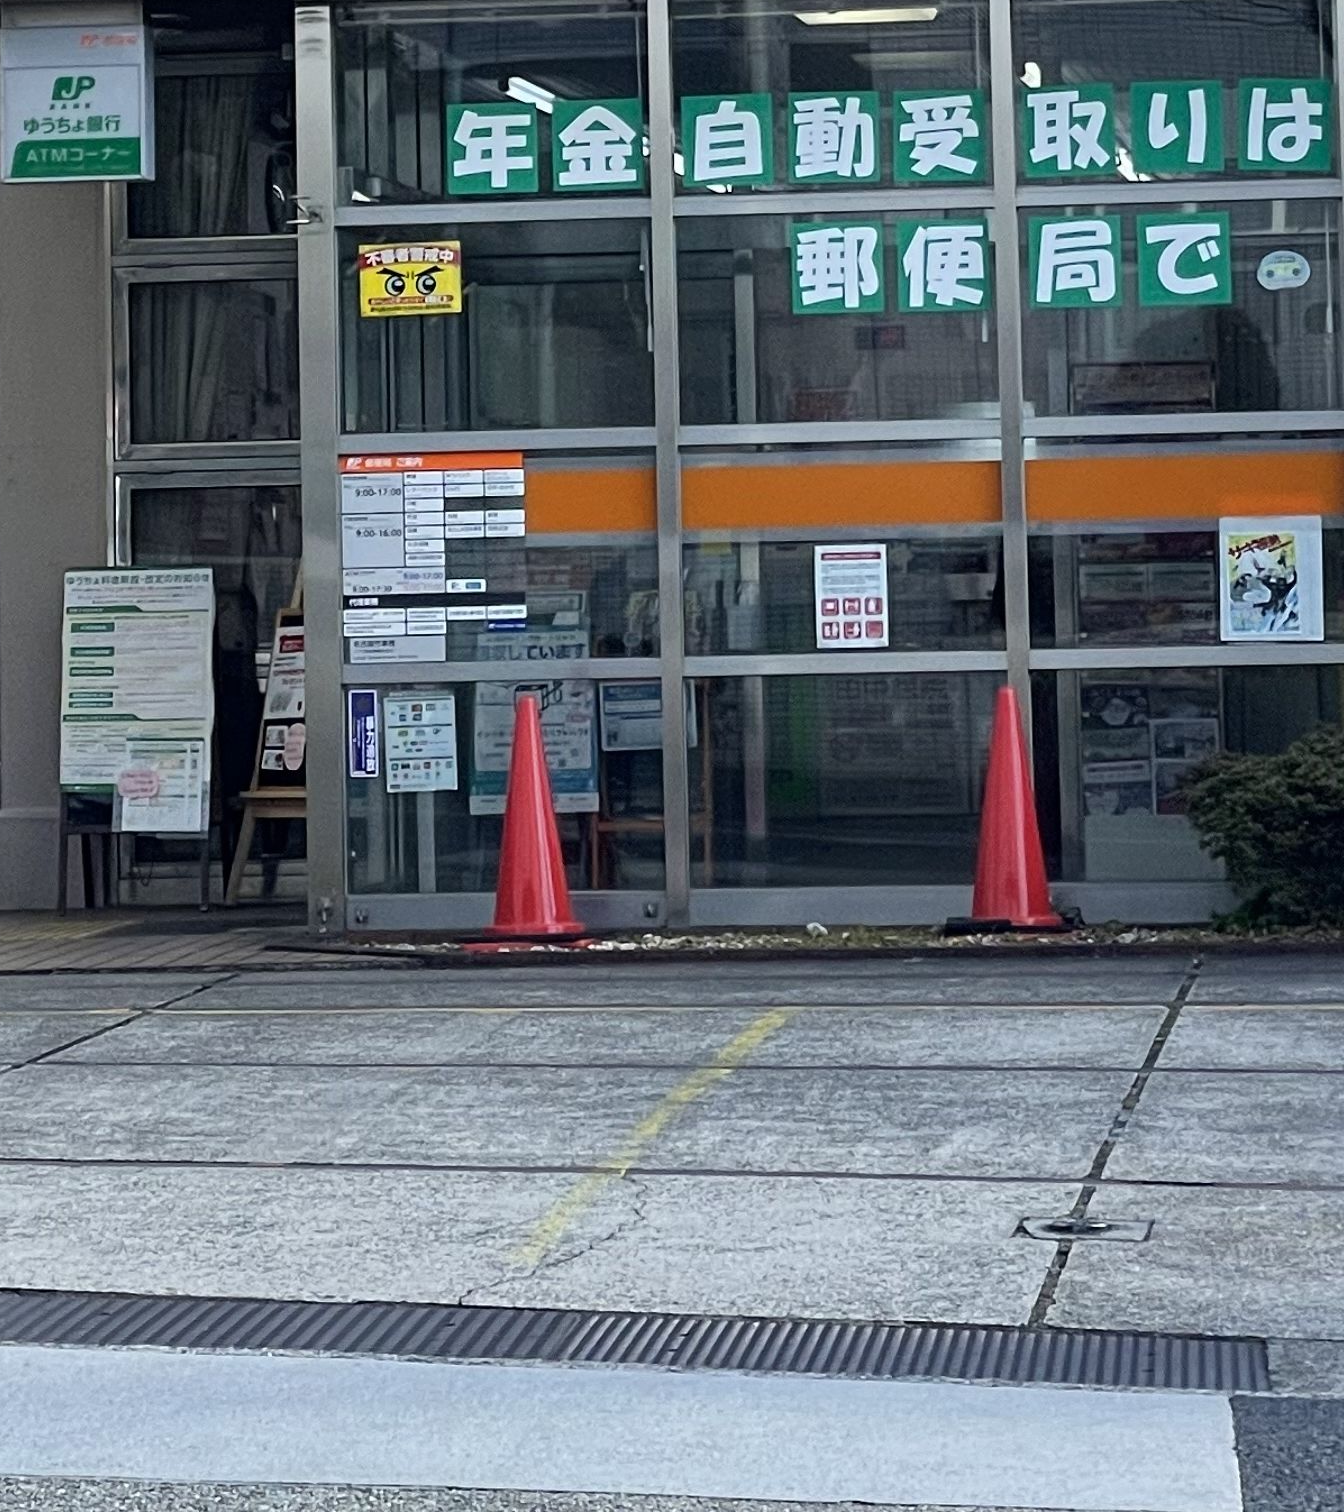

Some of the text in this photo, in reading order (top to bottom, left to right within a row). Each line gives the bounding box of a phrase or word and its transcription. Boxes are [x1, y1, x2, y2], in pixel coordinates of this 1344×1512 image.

[23, 115, 121, 135] ゆうちょ銀行
[453, 87, 1323, 188] 年金自動受取りは
[26, 145, 132, 163] ATMコーナー
[796, 220, 1221, 308] 郵便局で
